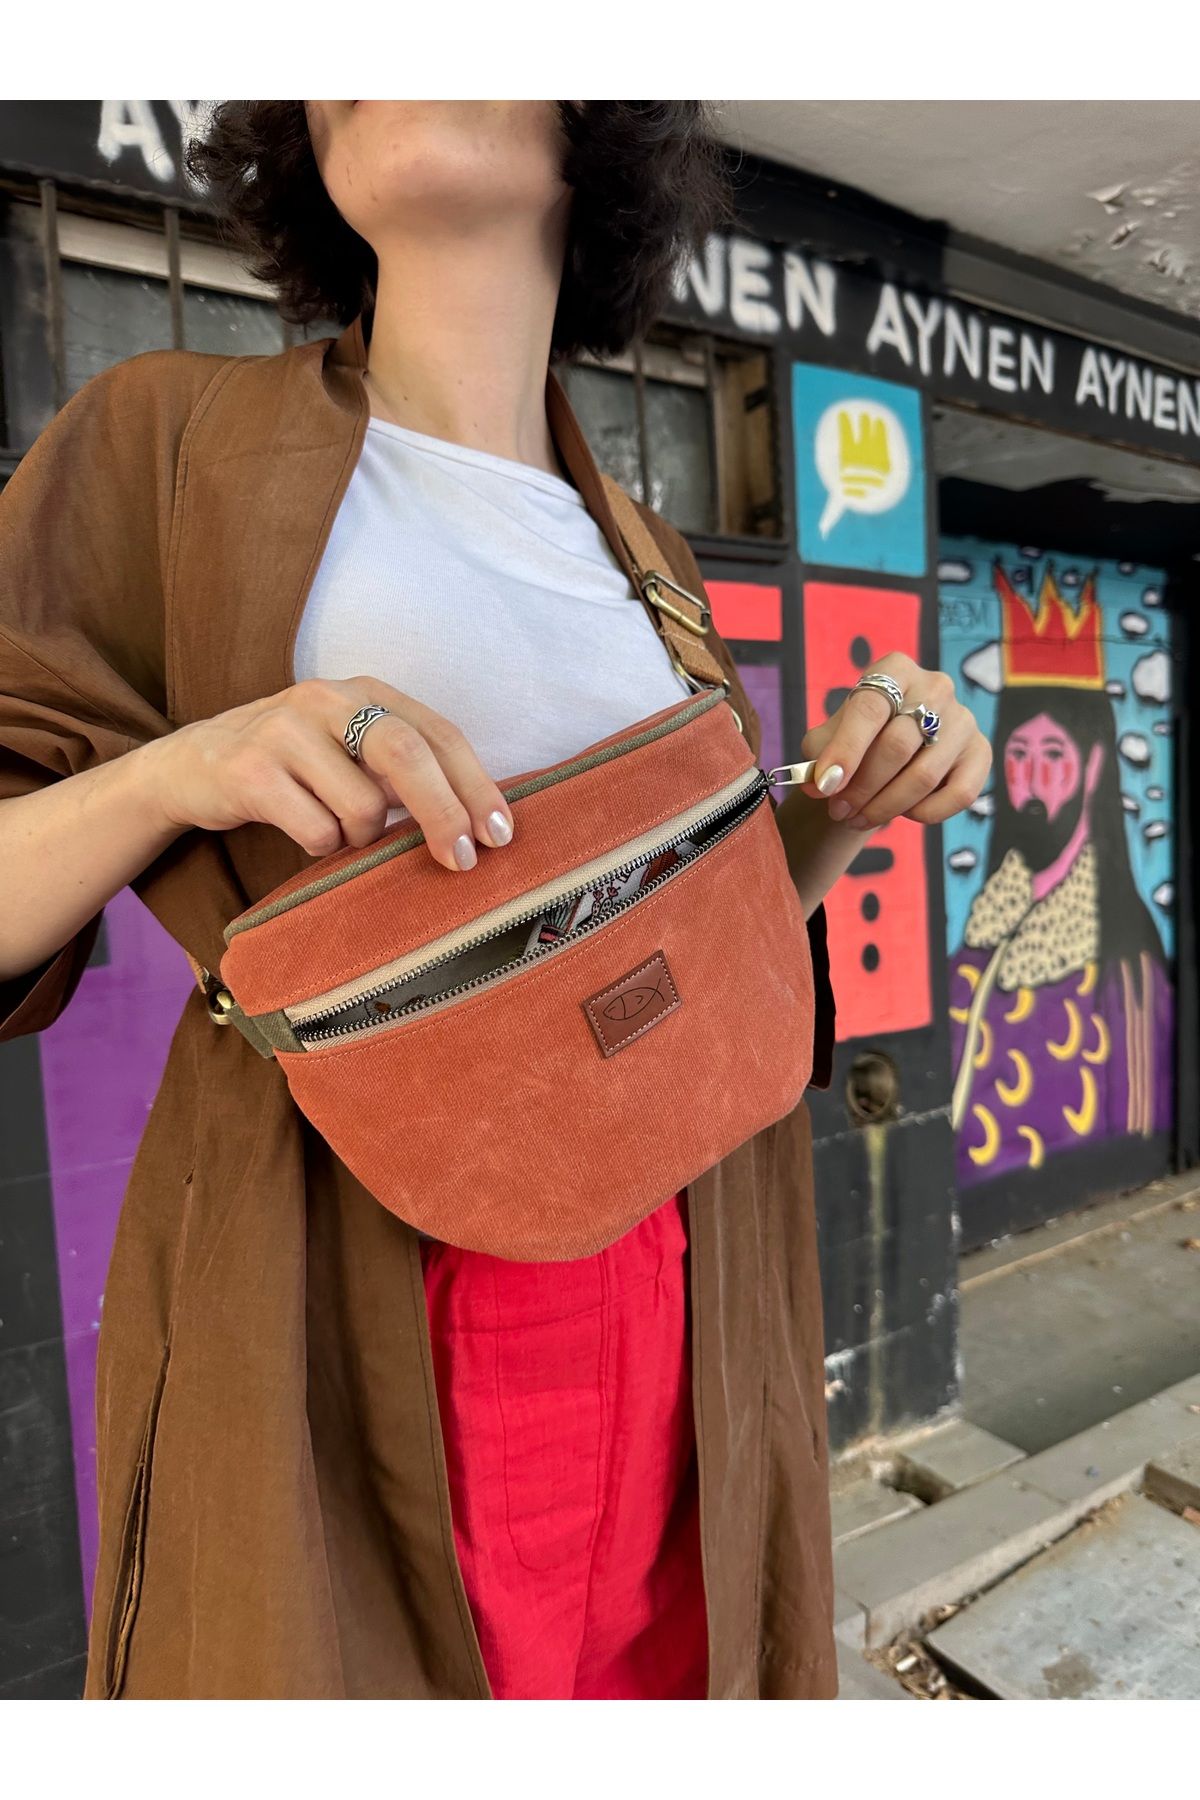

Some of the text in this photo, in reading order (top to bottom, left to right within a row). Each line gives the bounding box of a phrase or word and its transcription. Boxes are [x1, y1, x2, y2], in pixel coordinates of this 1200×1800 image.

[98, 100, 258, 198] AY
[866, 283, 1056, 395] AYNEN
[1074, 346, 1200, 438] AYNEN
